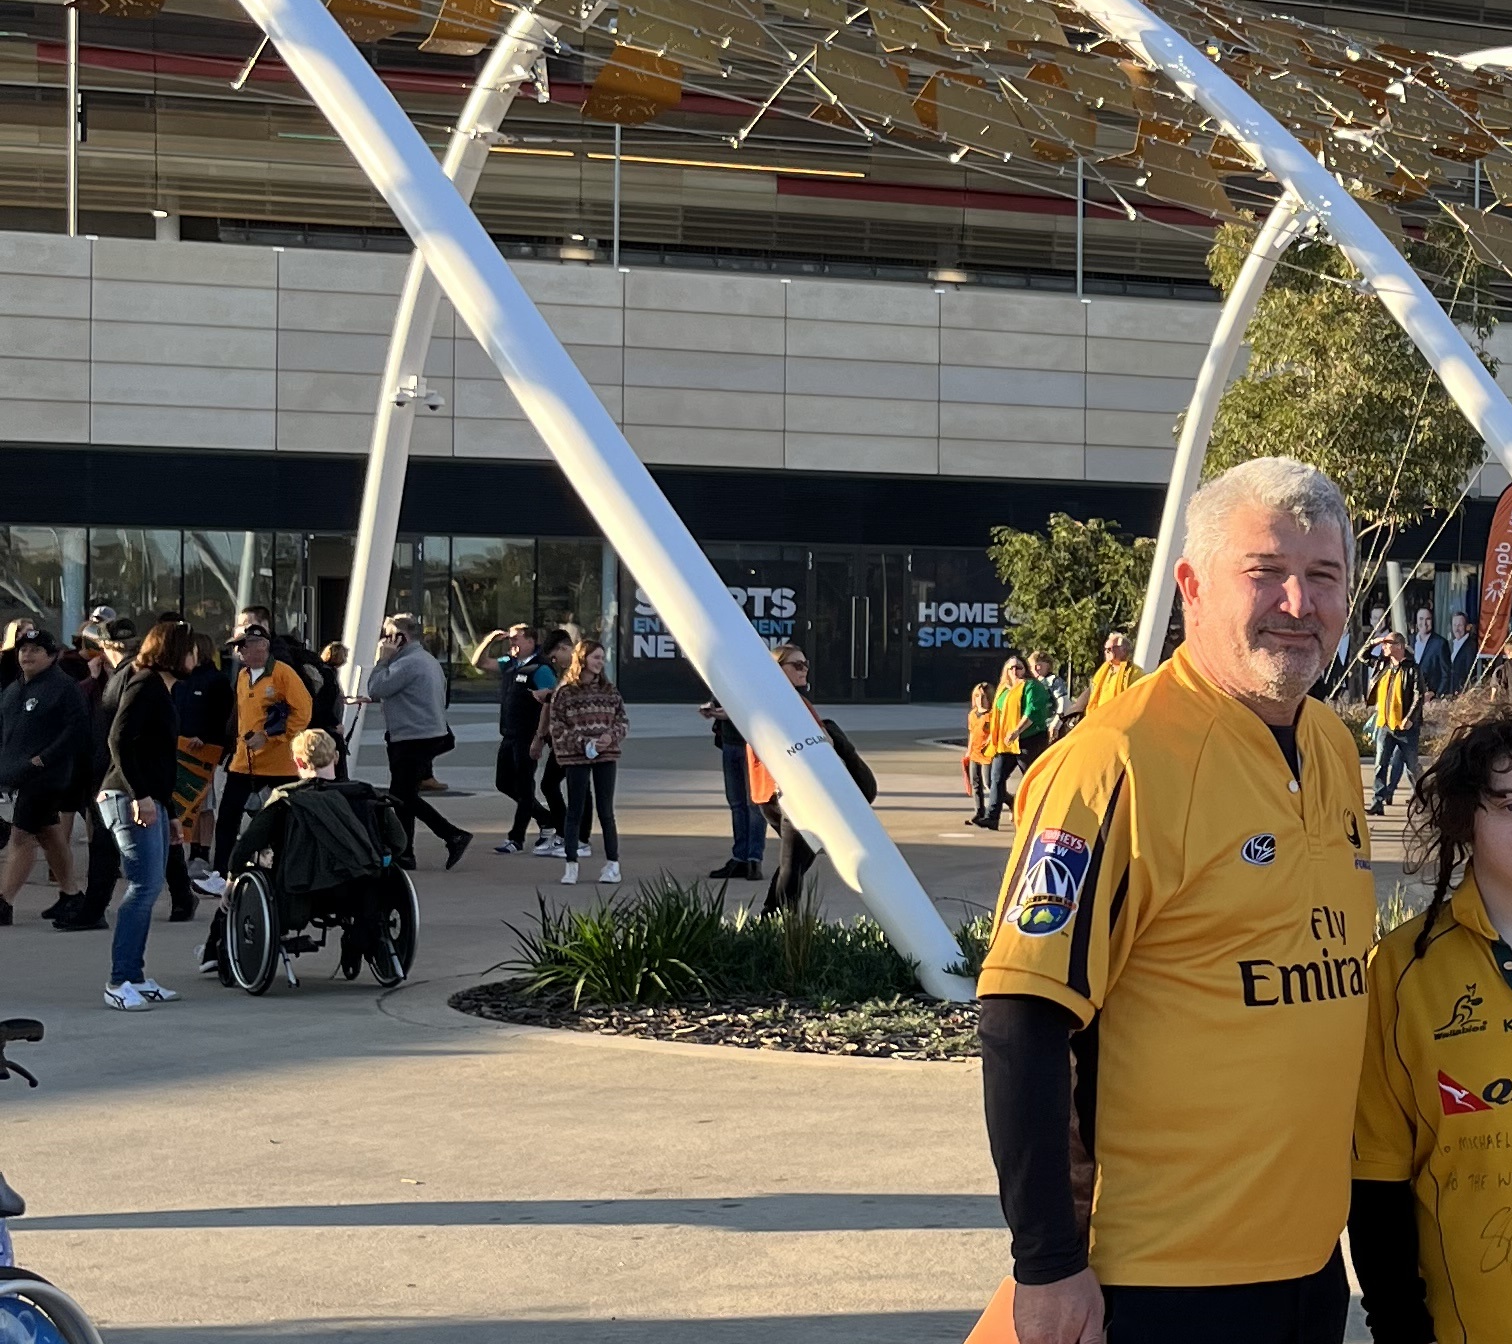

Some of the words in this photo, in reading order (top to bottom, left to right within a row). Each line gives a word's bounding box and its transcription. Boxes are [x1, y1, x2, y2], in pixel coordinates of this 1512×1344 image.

[918, 602, 998, 623] HOME
[786, 742, 804, 756] NO
[1311, 906, 1346, 945] Fly
